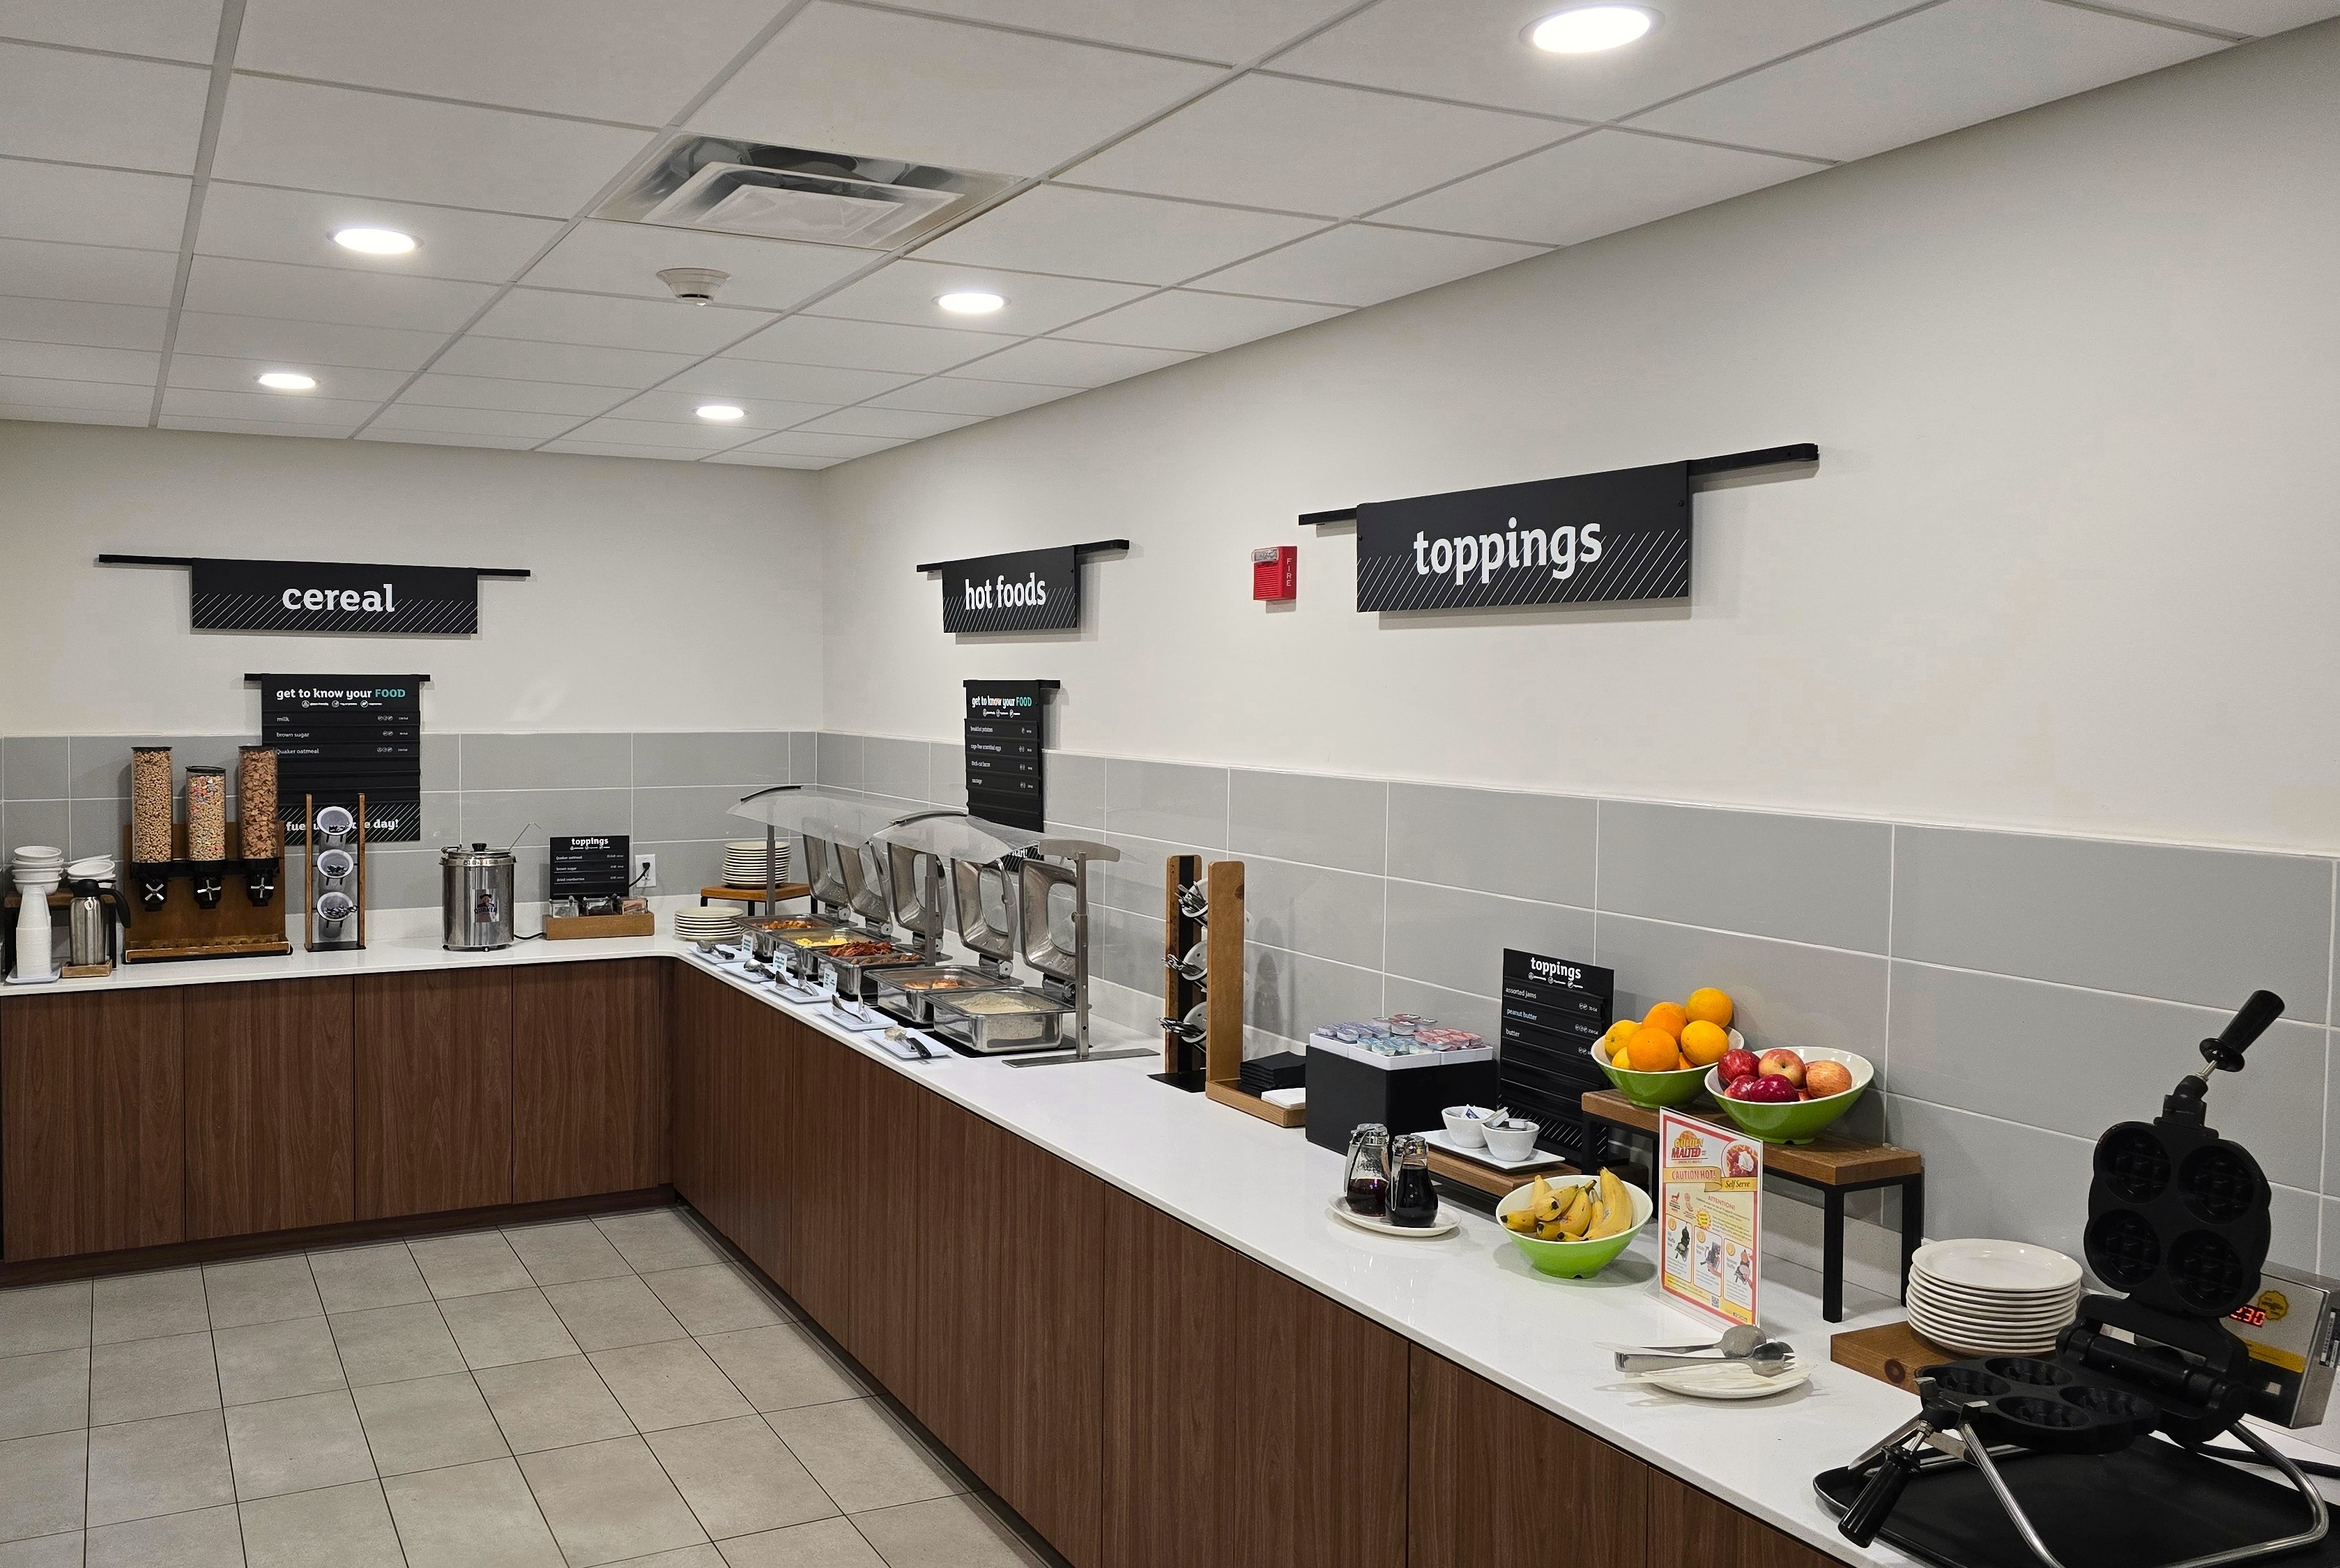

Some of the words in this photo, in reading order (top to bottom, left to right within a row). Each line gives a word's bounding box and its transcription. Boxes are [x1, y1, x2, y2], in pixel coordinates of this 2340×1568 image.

[1414, 517, 1603, 586] toppings
[965, 578, 993, 610] hot
[996, 572, 1046, 608] foods
[282, 583, 395, 613] cereal
[276, 689, 296, 700] get
[298, 689, 311, 698] to
[313, 688, 344, 698] know
[346, 690, 372, 700] your
[375, 689, 406, 698] FOOD
[972, 696, 981, 708] get
[981, 696, 987, 706] to
[987, 695, 1002, 706] know
[1002, 698, 1016, 709] your
[1016, 696, 1032, 707] FOOD
[286, 822, 306, 831] fue
[373, 818, 399, 831] day!
[572, 838, 609, 846] toppings
[1531, 957, 1581, 981] toppings
[1506, 987, 1525, 997] assorted
[1525, 990, 1537, 999] jams
[1506, 1008, 1523, 1017] peanut
[1523, 1011, 1538, 1020] butter
[1506, 1028, 1520, 1037] butter
[1674, 1137, 1704, 1148] GOLDEN
[1672, 1148, 1701, 1158] MALTED
[1672, 1170, 1699, 1180] CAUTION
[1700, 1169, 1716, 1180] HOT!
[1726, 1180, 1736, 1189] Self
